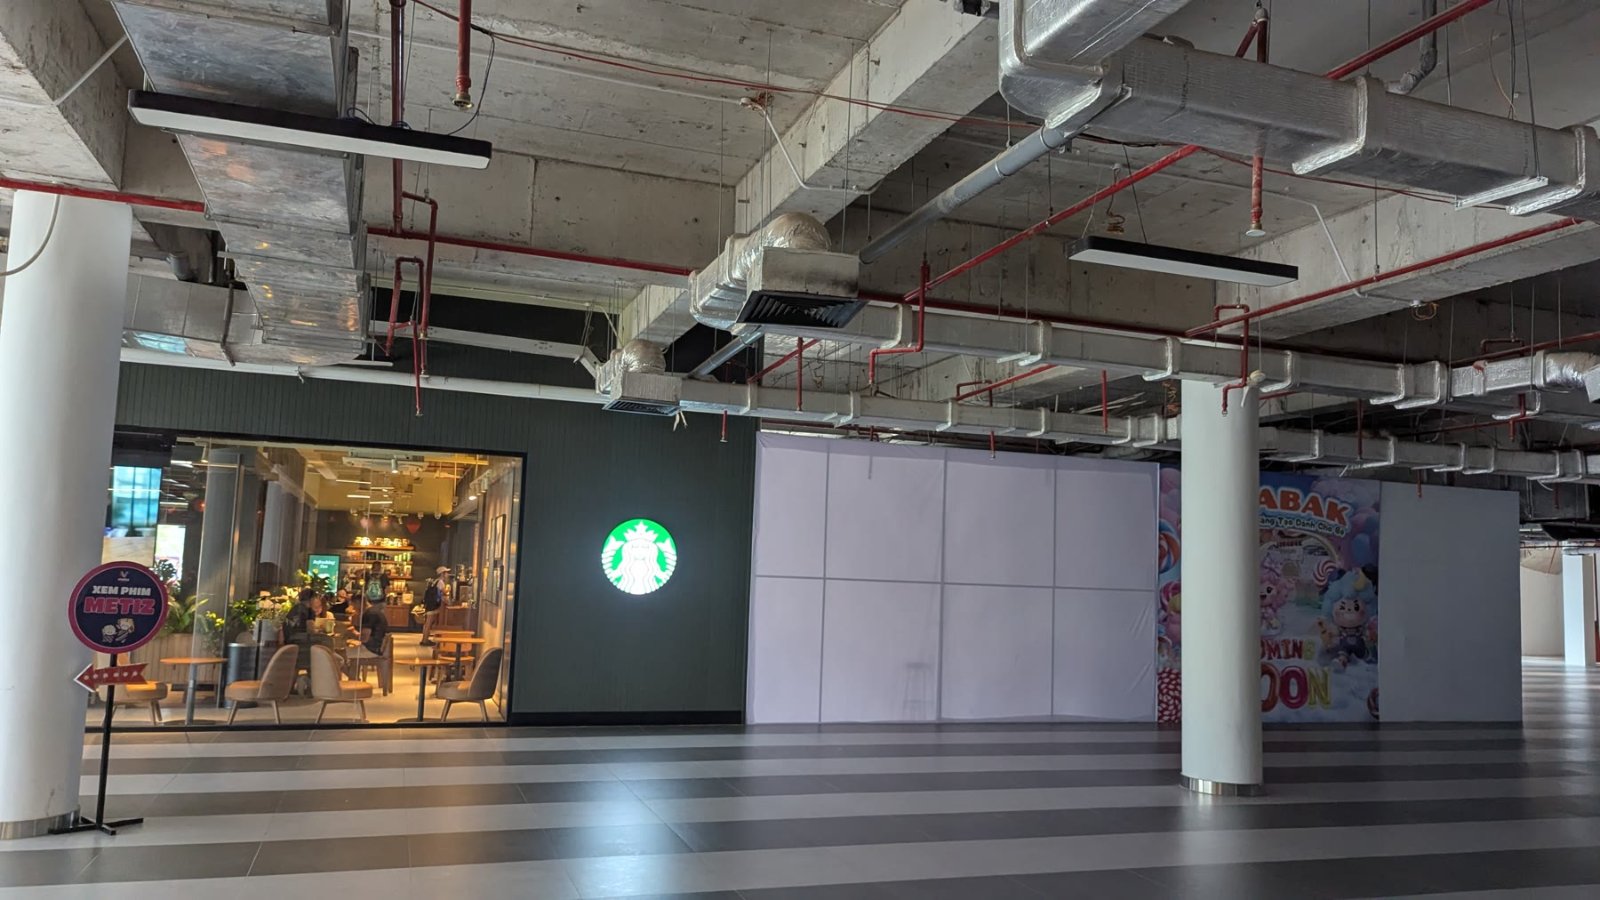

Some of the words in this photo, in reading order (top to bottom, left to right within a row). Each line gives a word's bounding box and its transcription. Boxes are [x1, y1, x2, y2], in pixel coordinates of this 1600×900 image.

[92, 585, 118, 595] XEM
[120, 586, 151, 596] PHIM
[83, 596, 155, 615] METIZ
[1261, 639, 1315, 660] MING
[1261, 662, 1330, 712] OON
